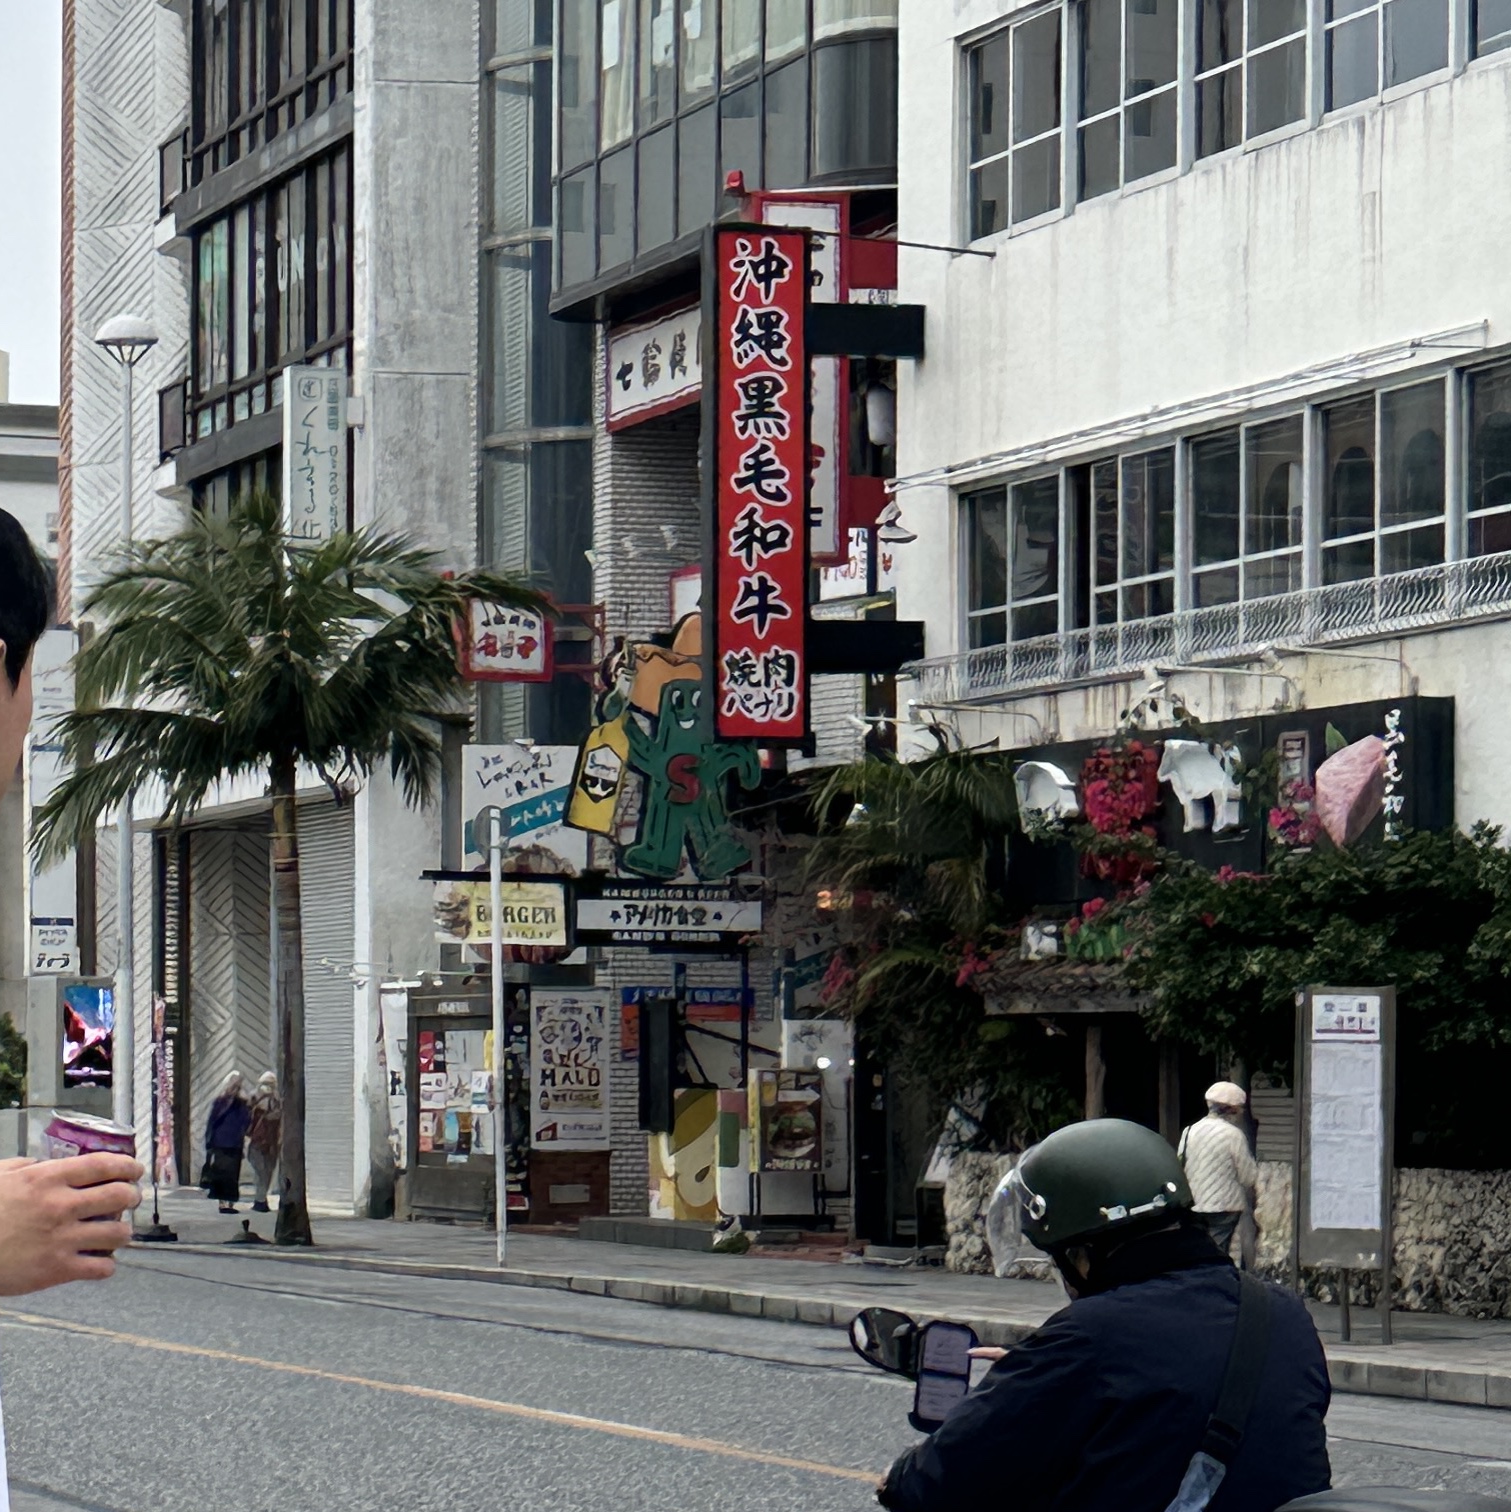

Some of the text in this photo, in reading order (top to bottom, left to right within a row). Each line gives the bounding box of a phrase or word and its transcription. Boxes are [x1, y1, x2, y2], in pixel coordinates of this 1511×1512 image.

[731, 237, 792, 642] 沖縄黒毛和牛
[723, 647, 799, 690] 焼肉
[721, 688, 799, 722] パナリ
